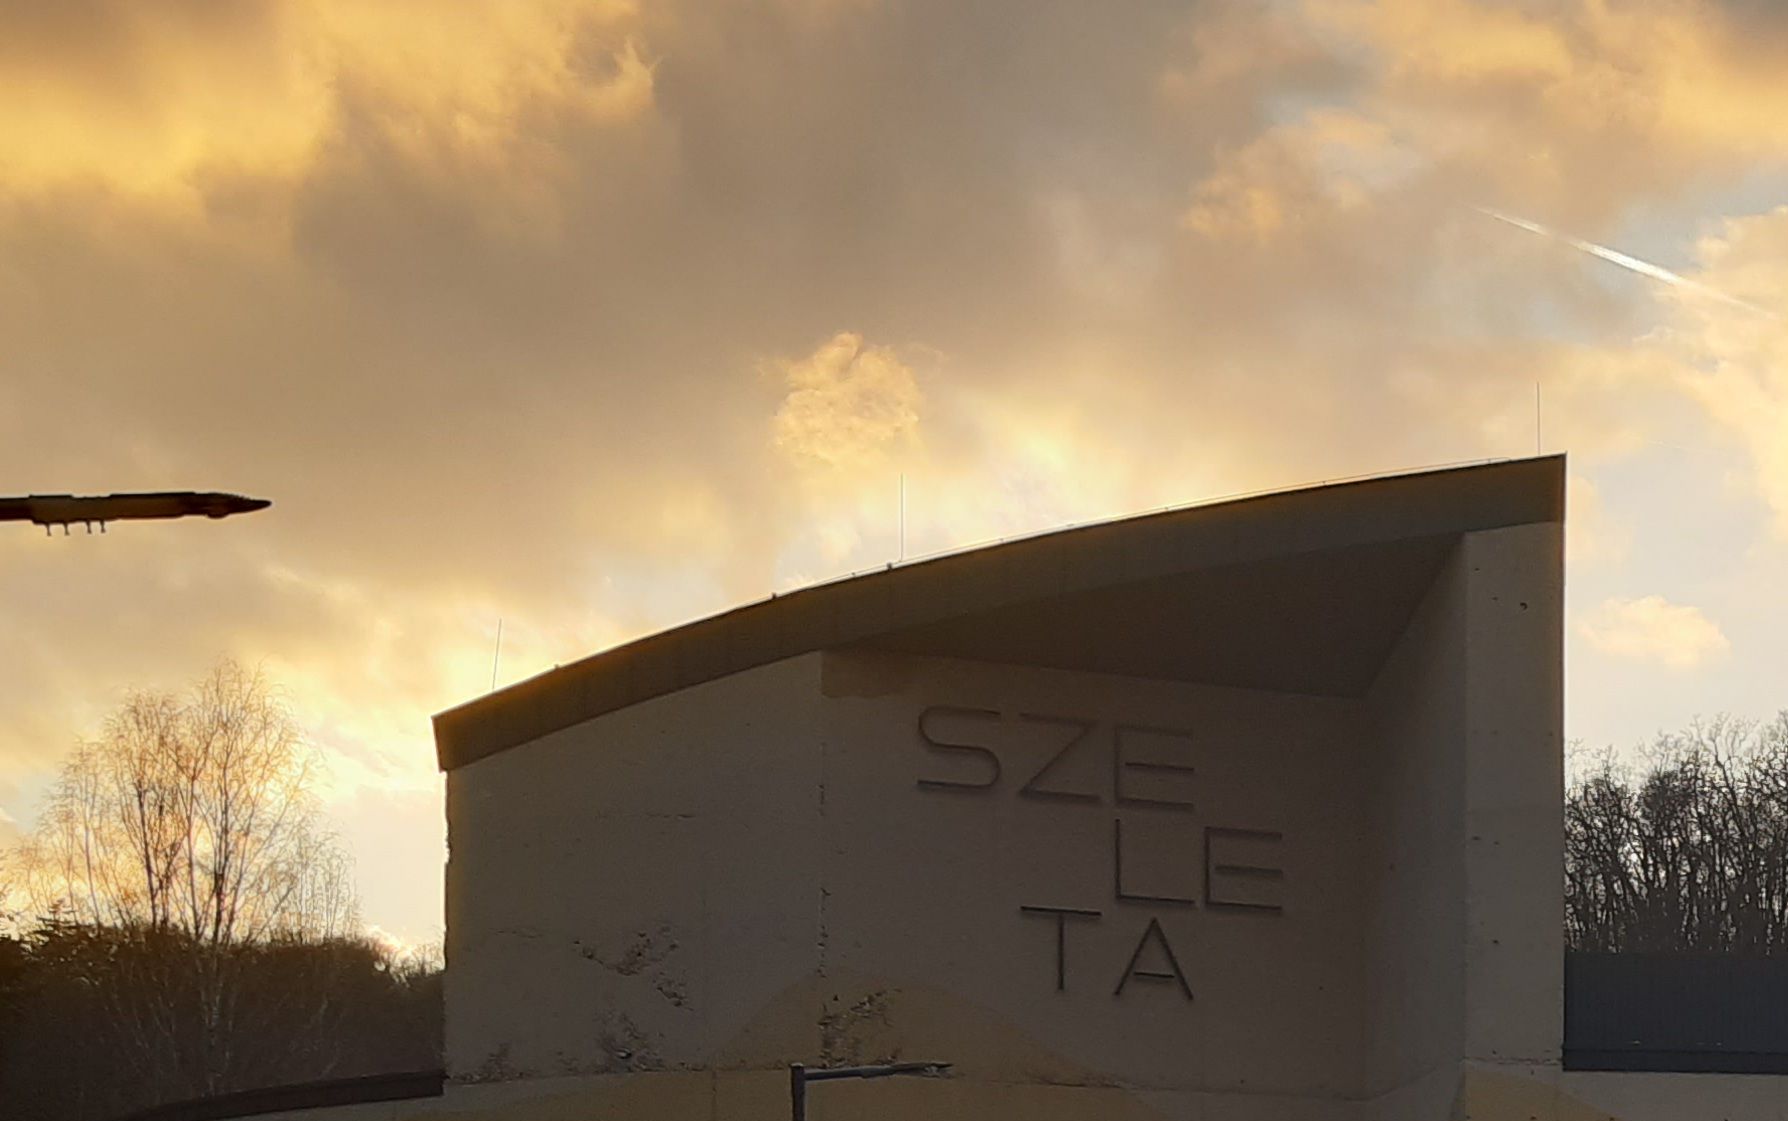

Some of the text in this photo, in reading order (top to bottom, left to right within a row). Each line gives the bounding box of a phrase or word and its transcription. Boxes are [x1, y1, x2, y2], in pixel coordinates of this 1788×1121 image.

[917, 705, 1194, 810] SZE
[1115, 818, 1283, 912] LE
[1020, 905, 1194, 1000] TA
